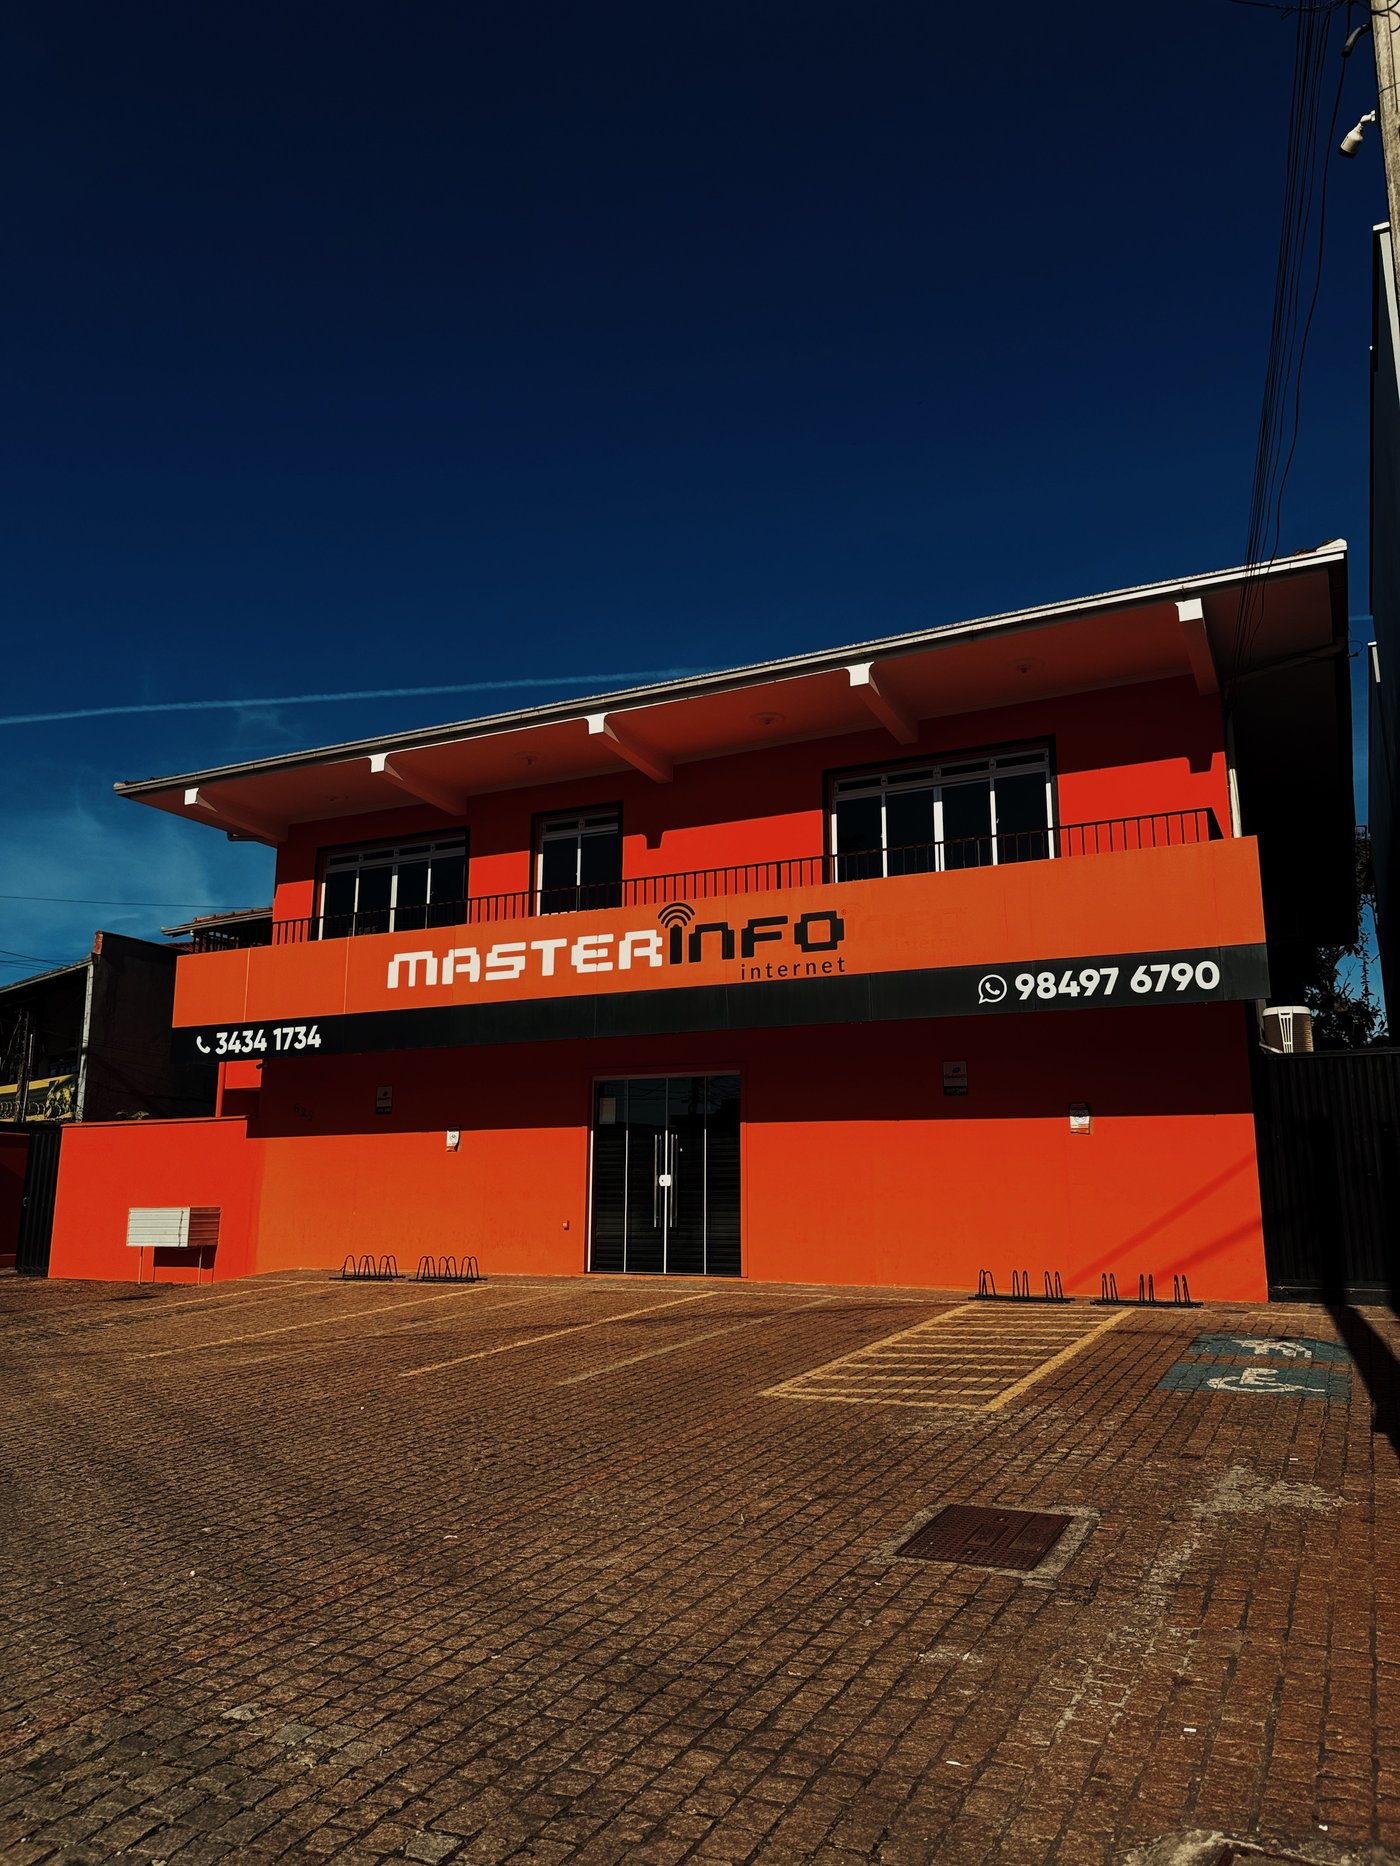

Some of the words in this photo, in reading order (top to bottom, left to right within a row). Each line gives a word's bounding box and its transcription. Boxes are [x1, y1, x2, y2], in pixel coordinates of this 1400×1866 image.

[740, 956, 846, 980] internet
[1014, 966, 1120, 1001] 98497
[1129, 960, 1221, 994] 6790
[215, 1028, 268, 1055] 3434
[273, 1024, 322, 1051] 1734
